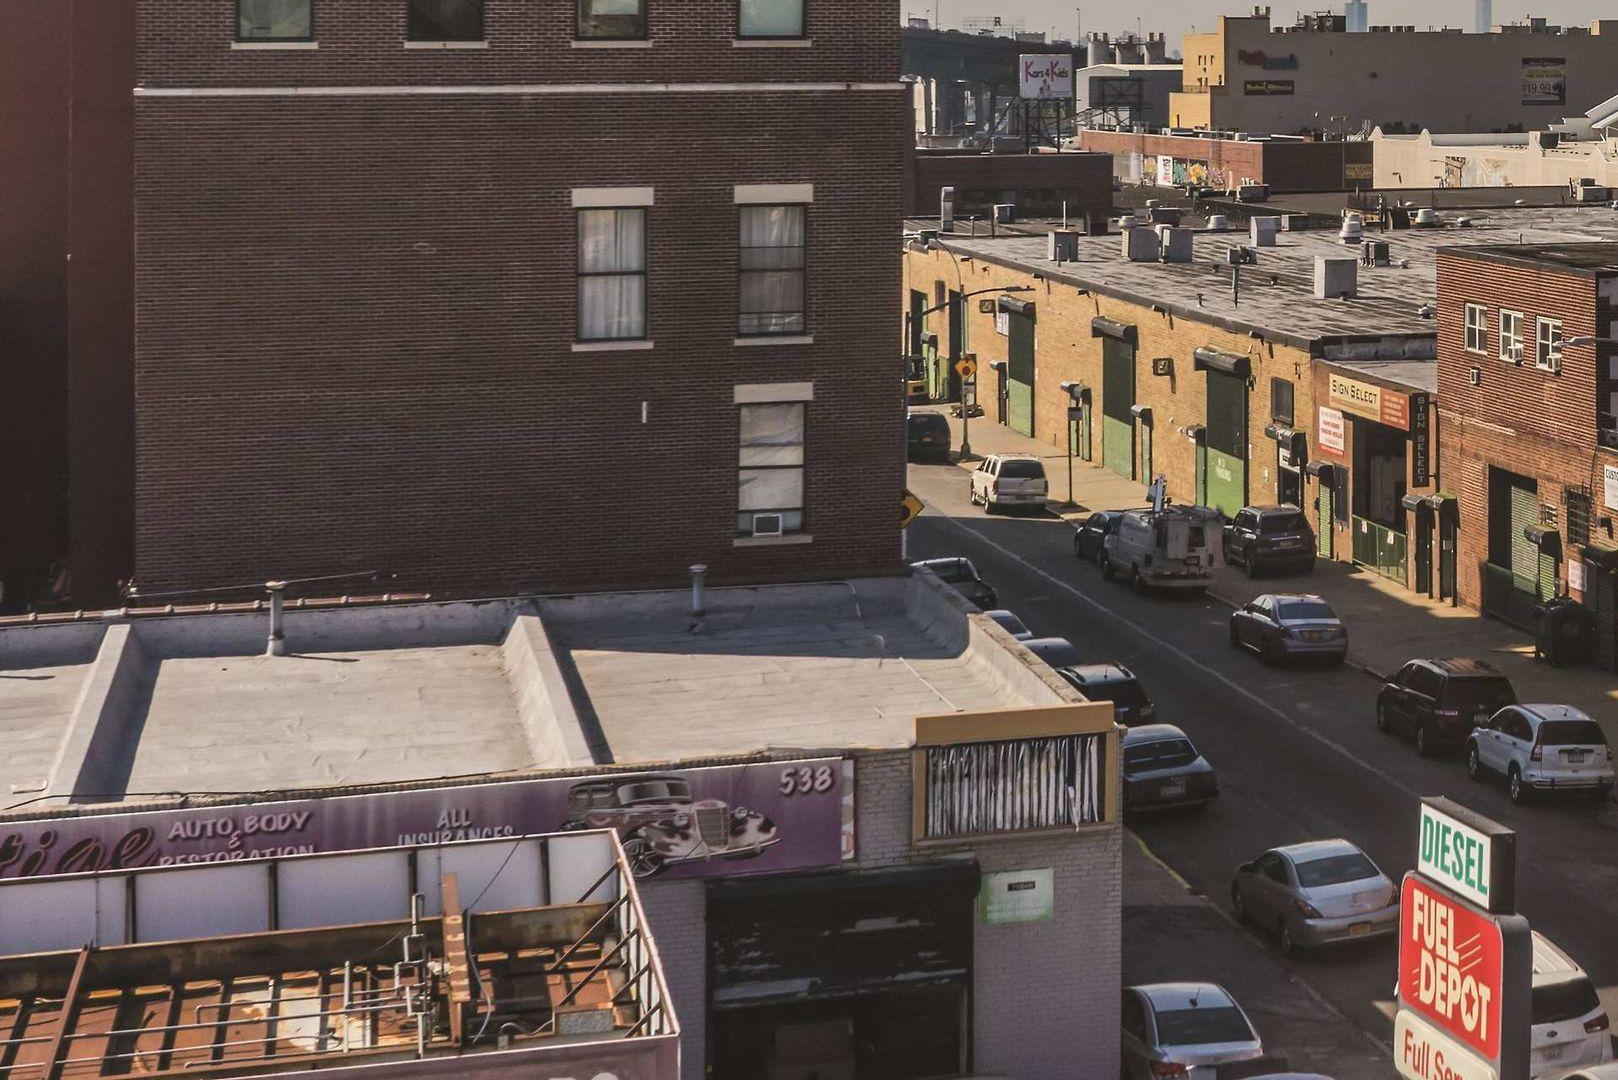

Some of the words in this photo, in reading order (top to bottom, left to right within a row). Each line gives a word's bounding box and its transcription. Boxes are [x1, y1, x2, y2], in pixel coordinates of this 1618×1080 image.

[780, 766, 832, 794] 538
[168, 818, 232, 840] AUTO
[244, 812, 310, 834] BODY
[436, 808, 472, 829] ALL
[1422, 813, 1488, 896] DIESEL
[1413, 888, 1459, 967] FUEL
[1419, 948, 1490, 1041] DEPOT
[1404, 1028, 1430, 1080] Full
